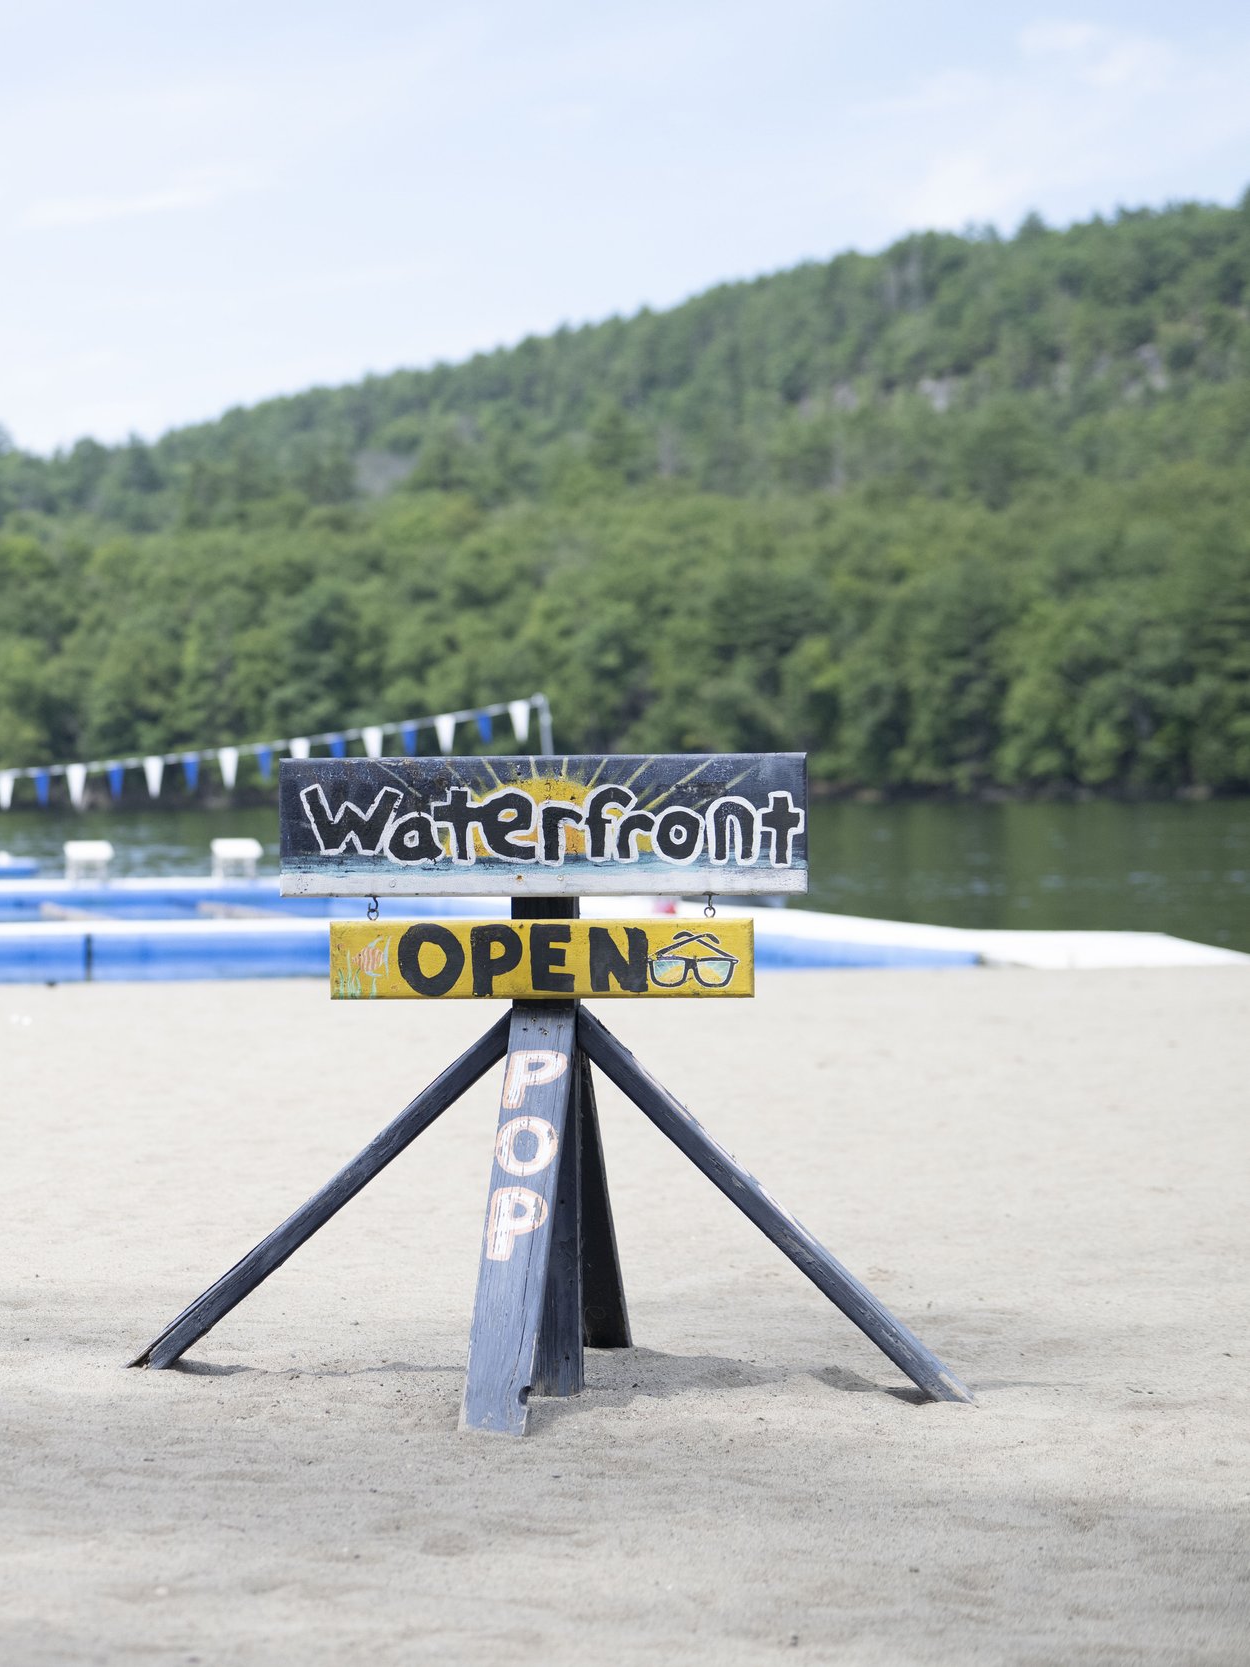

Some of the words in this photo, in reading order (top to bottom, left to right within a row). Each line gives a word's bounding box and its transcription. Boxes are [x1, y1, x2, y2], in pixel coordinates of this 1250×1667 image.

[299, 783, 805, 868] Waterfront
[397, 922, 649, 997] OPEN
[485, 1049, 568, 1262] POP
